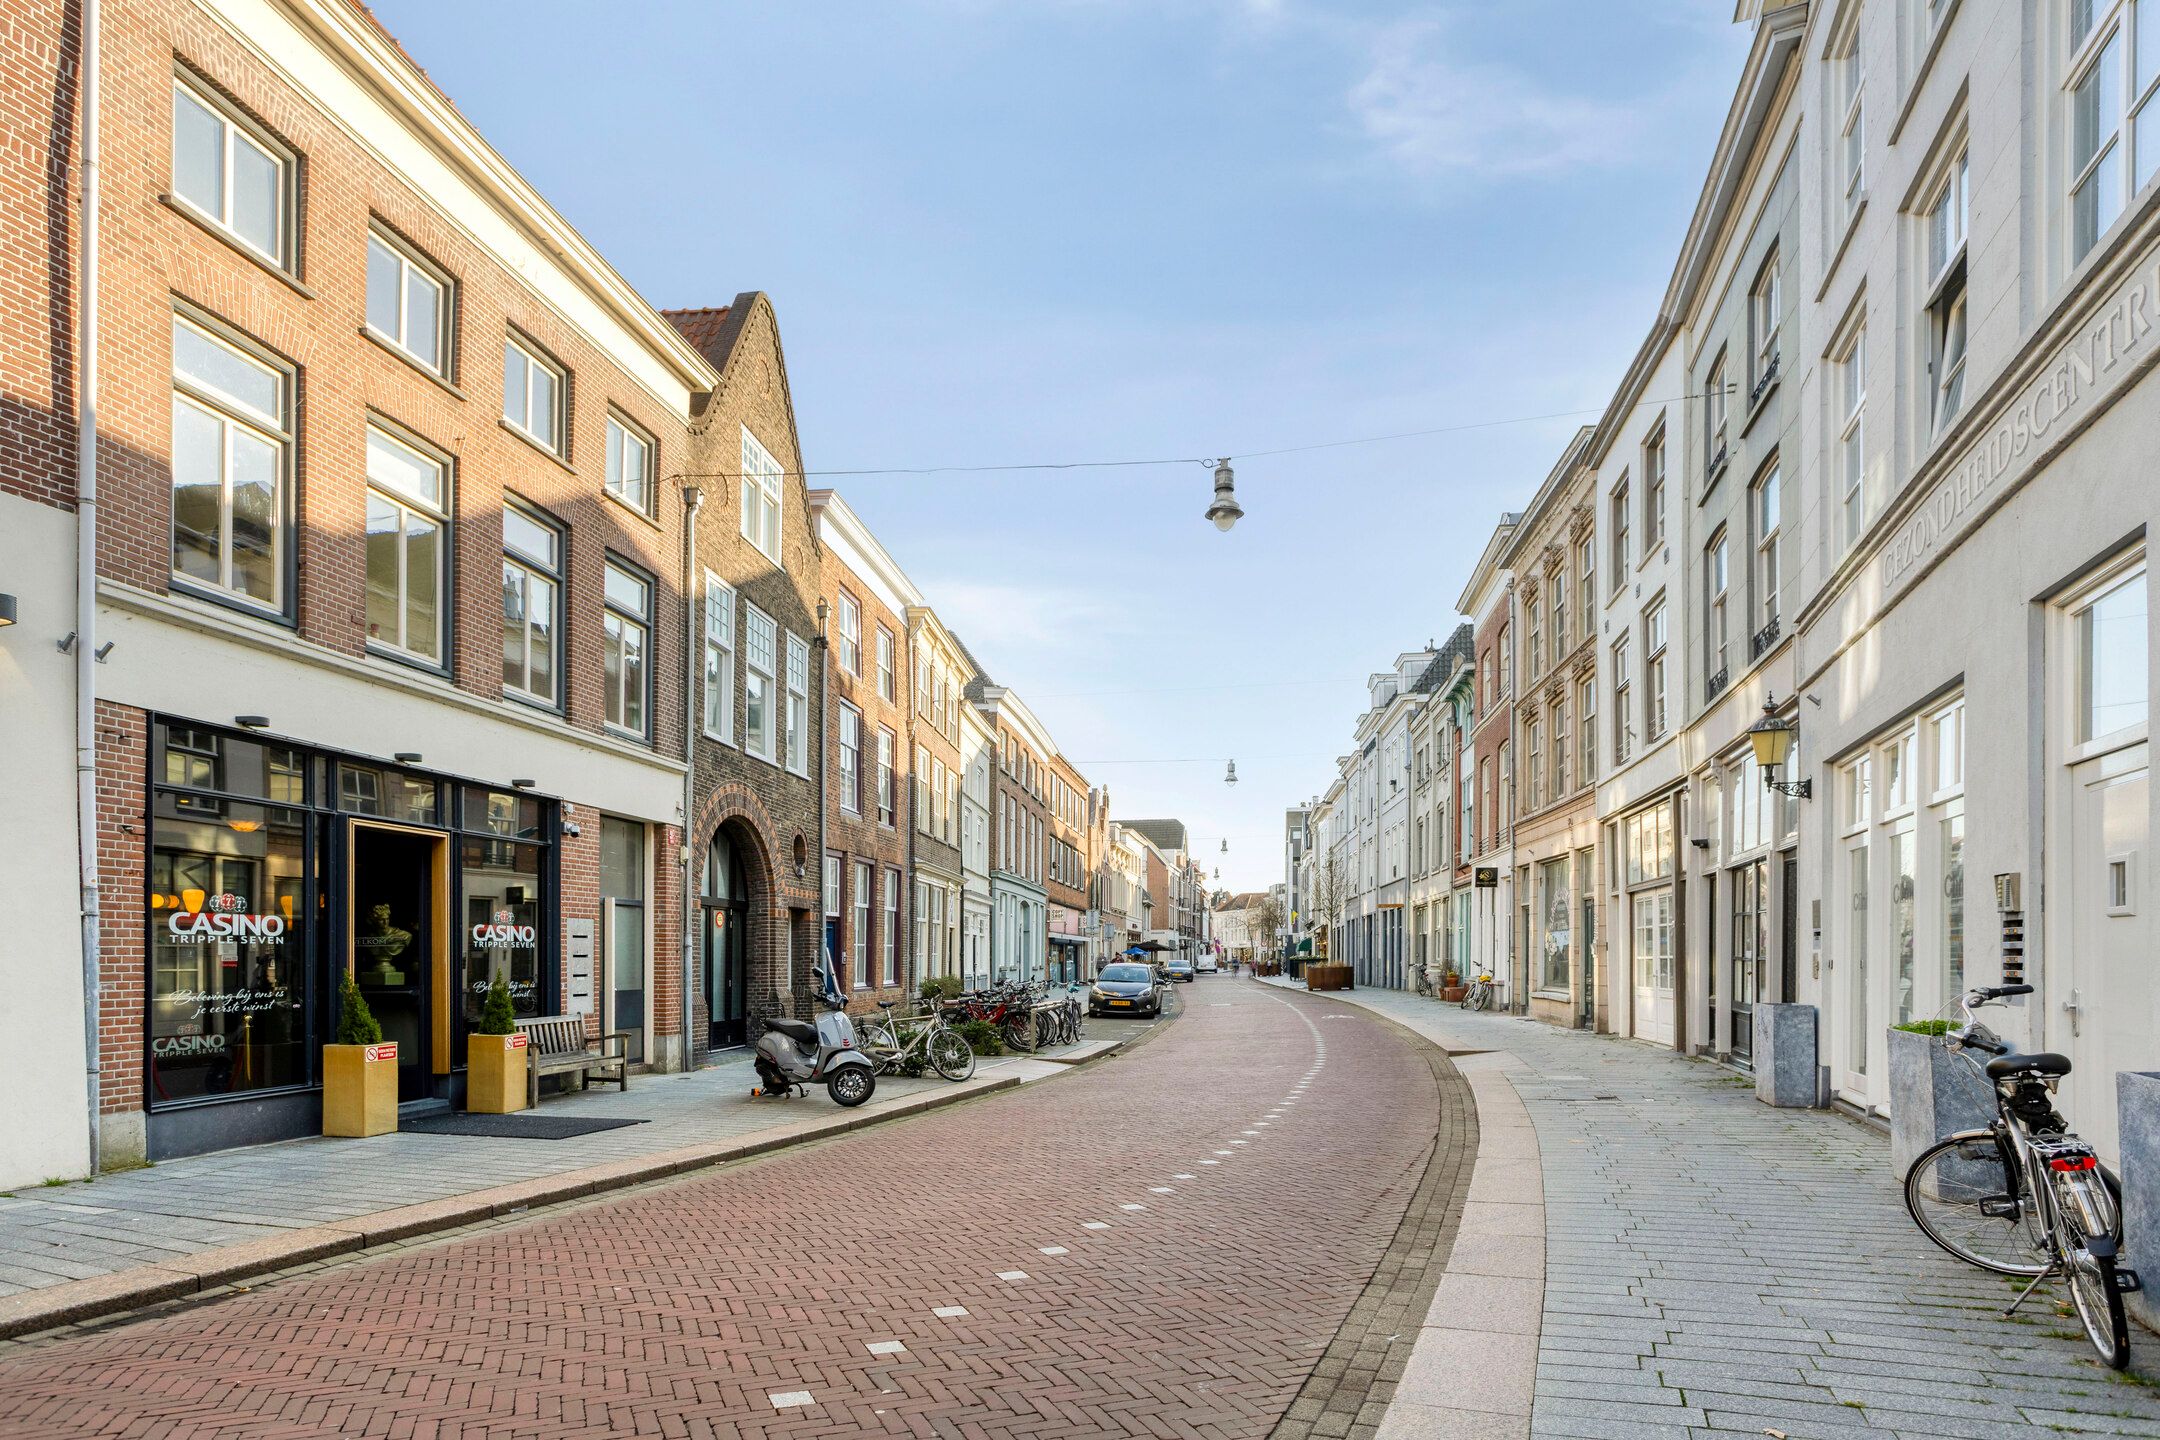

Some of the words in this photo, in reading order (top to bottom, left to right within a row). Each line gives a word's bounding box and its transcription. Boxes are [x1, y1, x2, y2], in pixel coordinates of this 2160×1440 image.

[168, 911, 284, 936] CASINO
[169, 935, 234, 944] TRIPPLE
[240, 936, 284, 945] SEVEN
[472, 924, 536, 942] CASINO
[473, 940, 508, 948] TRIPPLE
[511, 941, 536, 949] SEVEN
[235, 988, 252, 1004] bij
[254, 990, 273, 999] ons
[274, 990, 284, 998] is
[190, 1004, 206, 1020] je
[209, 1001, 240, 1014] eerste
[242, 999, 275, 1012] winst
[151, 1034, 226, 1053] CASINO
[153, 1050, 193, 1058] TRIPPLE
[196, 1047, 226, 1055] SEVEN
